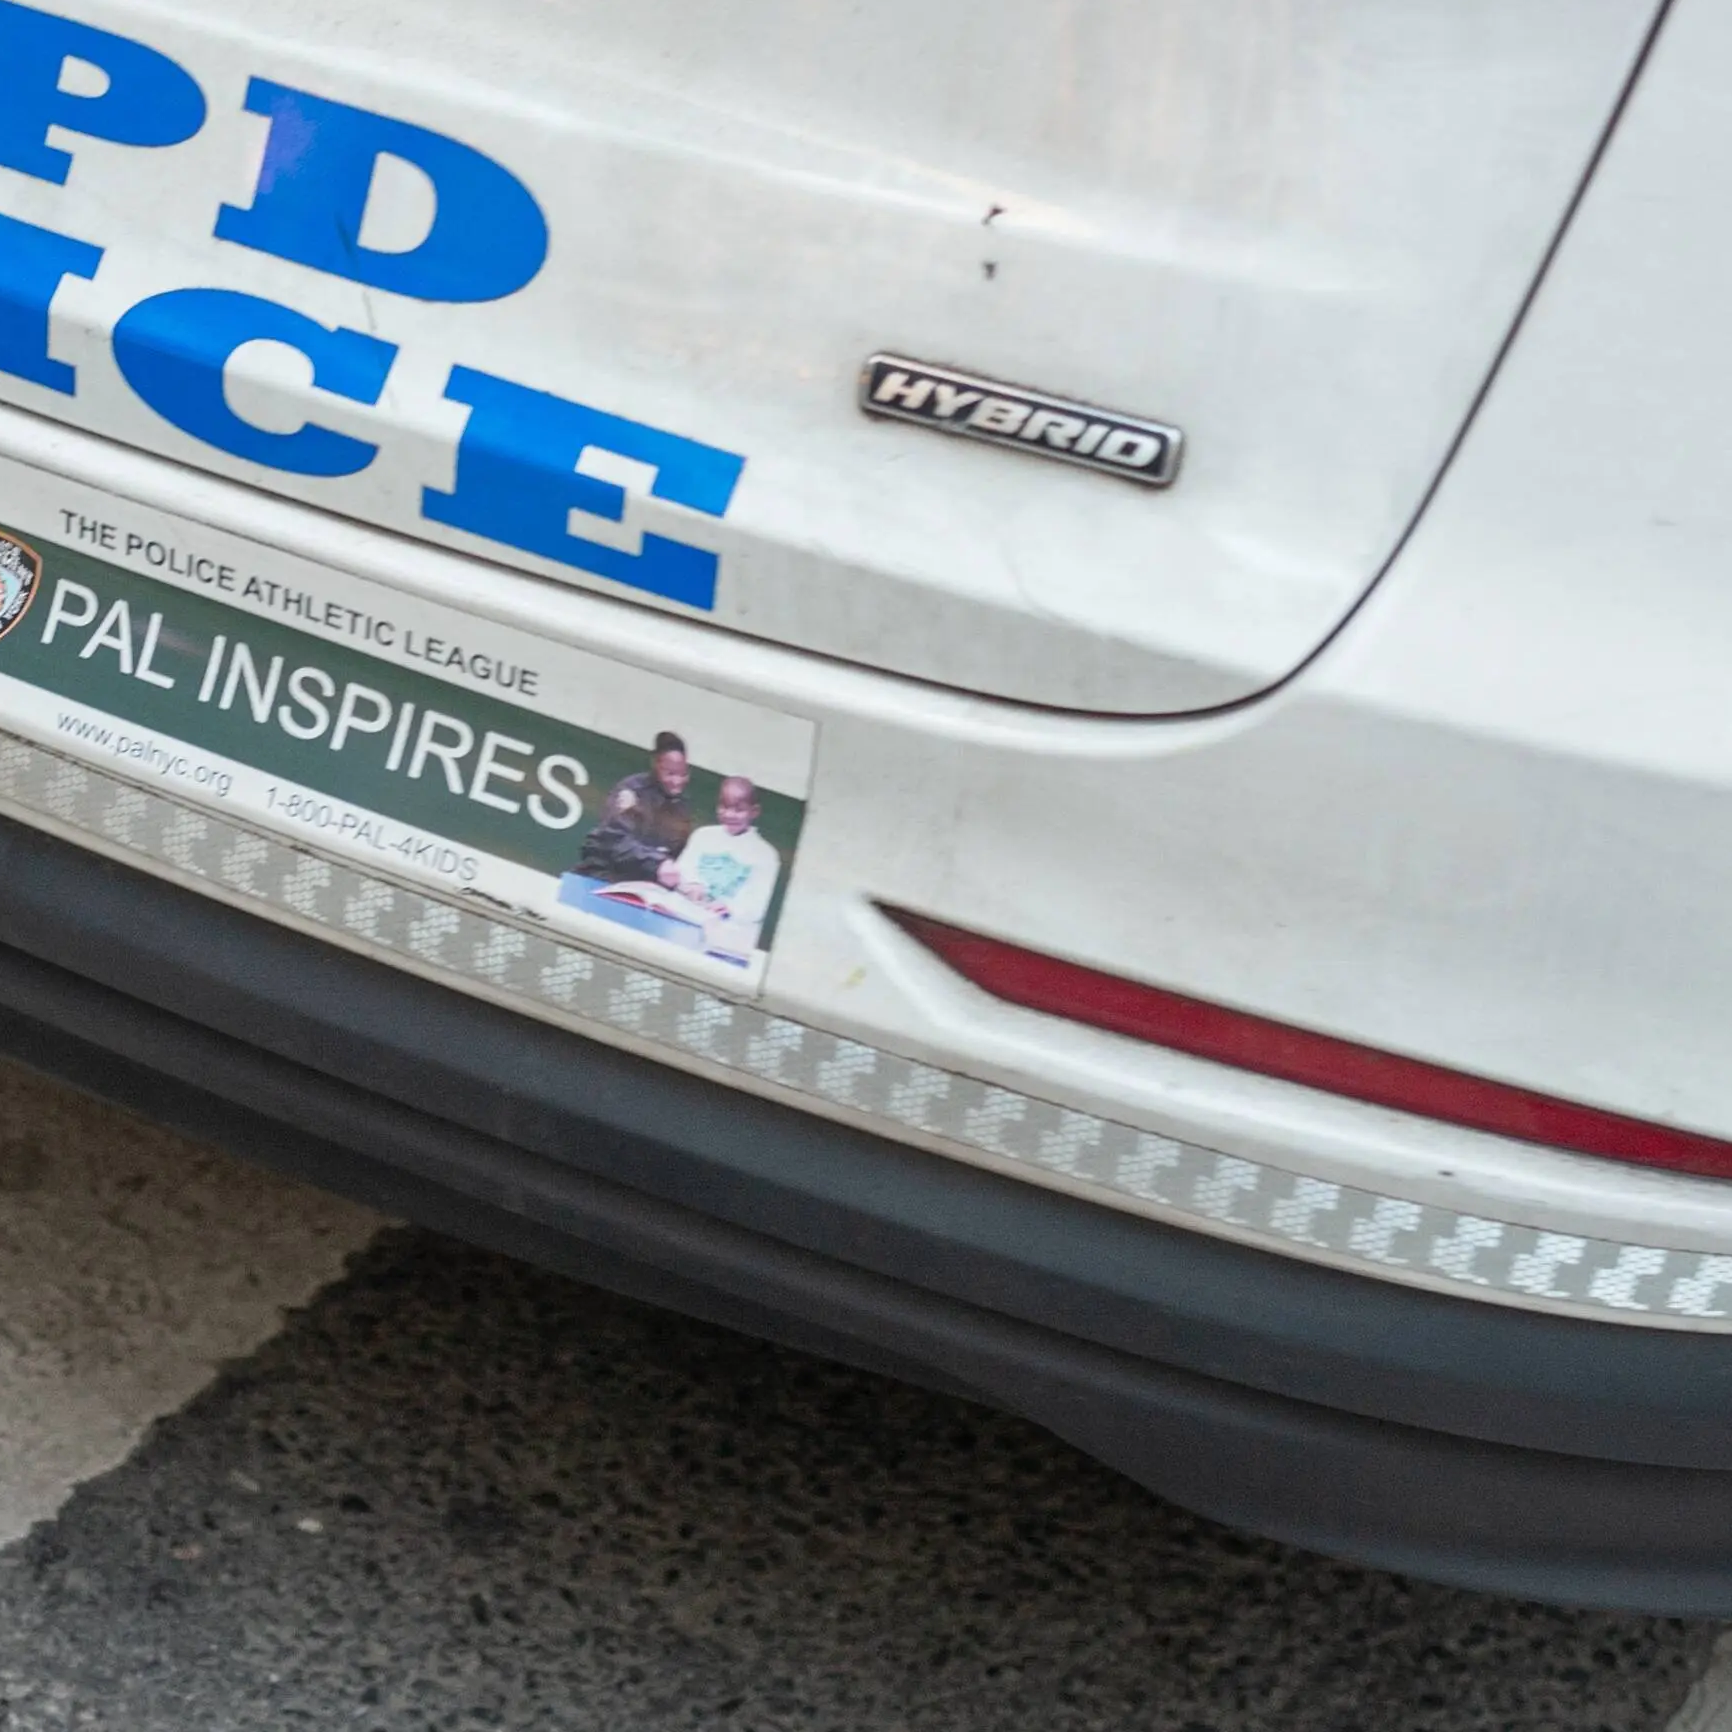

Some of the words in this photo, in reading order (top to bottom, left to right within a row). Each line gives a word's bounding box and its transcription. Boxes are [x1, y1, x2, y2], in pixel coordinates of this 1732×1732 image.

[872, 370, 1162, 468] HYBRID
[58, 508, 118, 552] THE
[122, 532, 237, 591] POLICE
[239, 573, 399, 648] ATHLETIC
[403, 627, 541, 698] LEAGUE
[39, 578, 177, 692] PAL
[196, 634, 589, 832] INSPIRES
[57, 711, 234, 798] www.palnyc.org
[267, 786, 481, 882] 1-800-PAL-4KIDS
